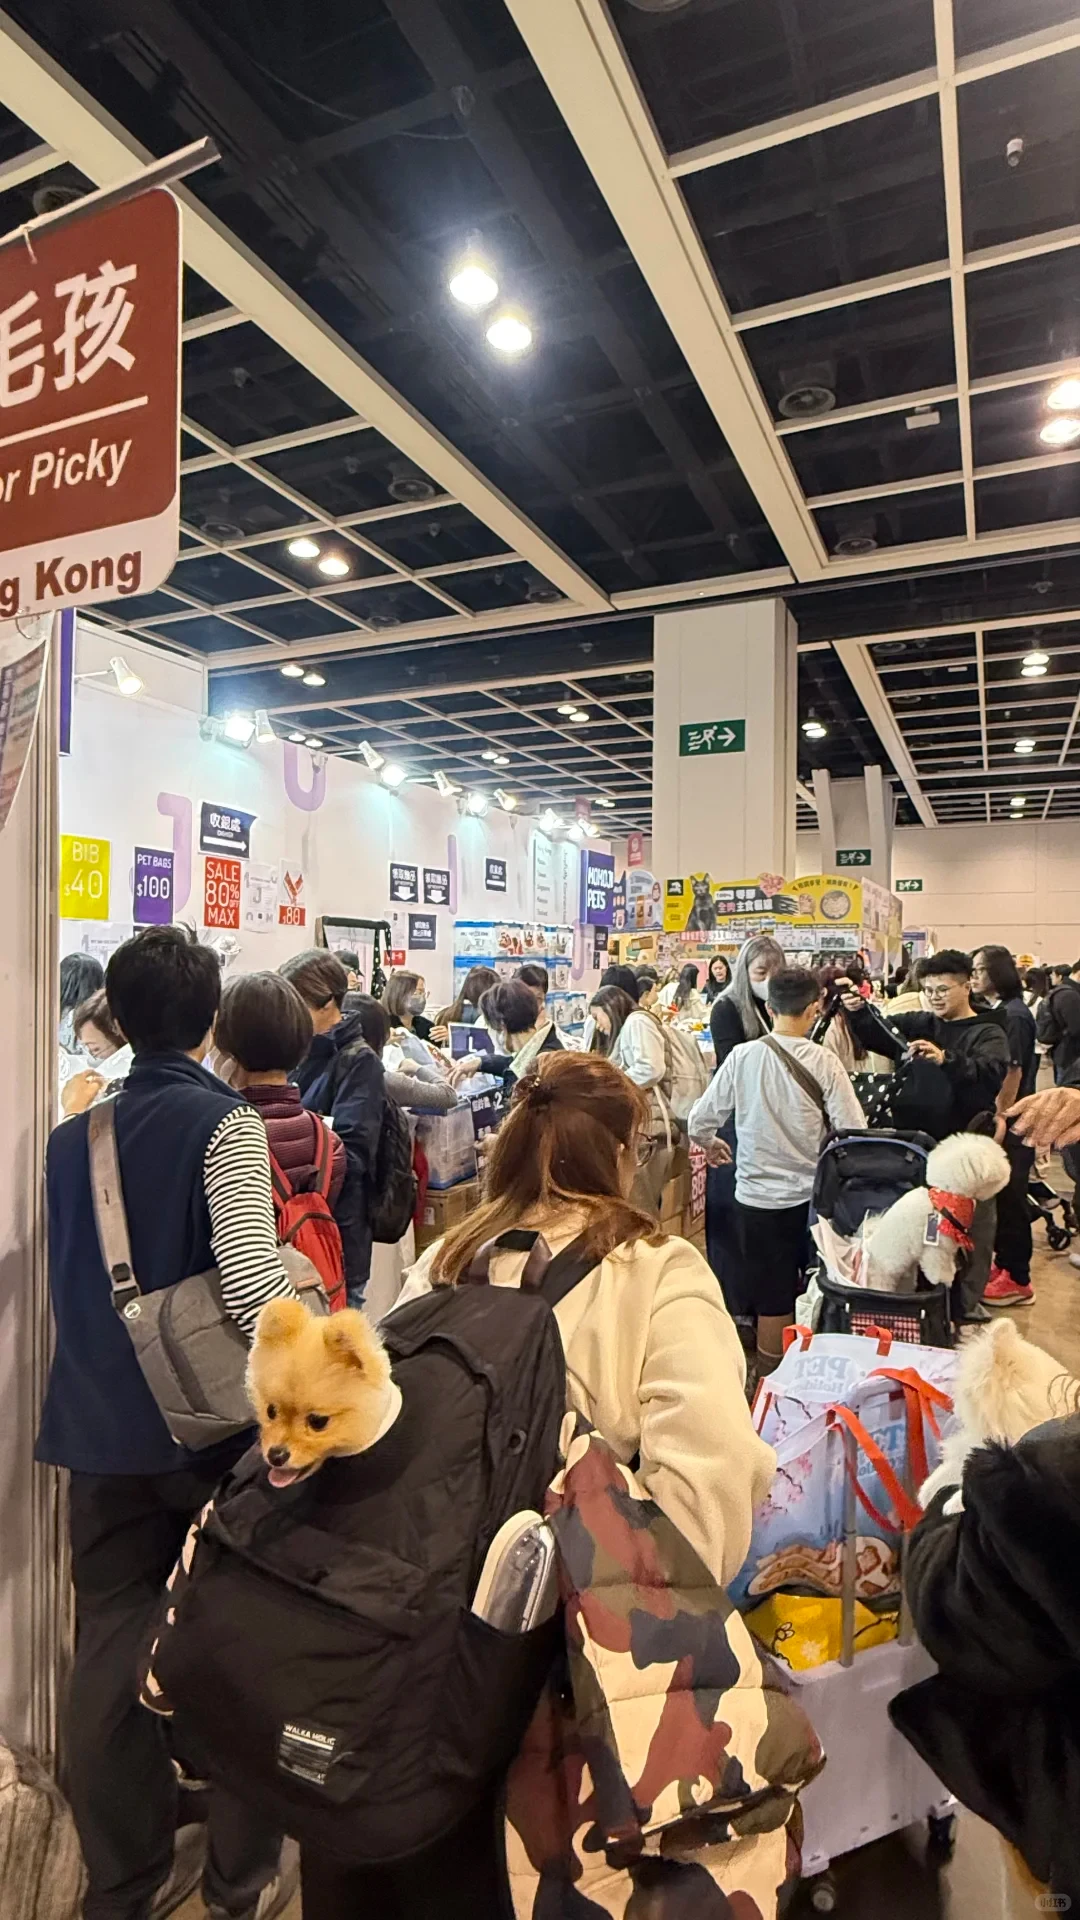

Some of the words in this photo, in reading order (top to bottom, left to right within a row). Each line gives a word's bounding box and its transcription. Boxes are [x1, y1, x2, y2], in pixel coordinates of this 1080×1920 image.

[0, 260, 137, 408] 毛孩
[28, 438, 133, 495] Picky
[35, 550, 142, 600] Kong
[72, 841, 100, 864] BIB
[137, 853, 151, 866] PET
[152, 855, 172, 869] BAGS
[63, 868, 103, 899] $40
[206, 861, 240, 883] SALE
[136, 874, 170, 899] $100
[205, 880, 240, 907] 80%
[587, 888, 607, 910] PETS
[207, 907, 235, 926] MAX
